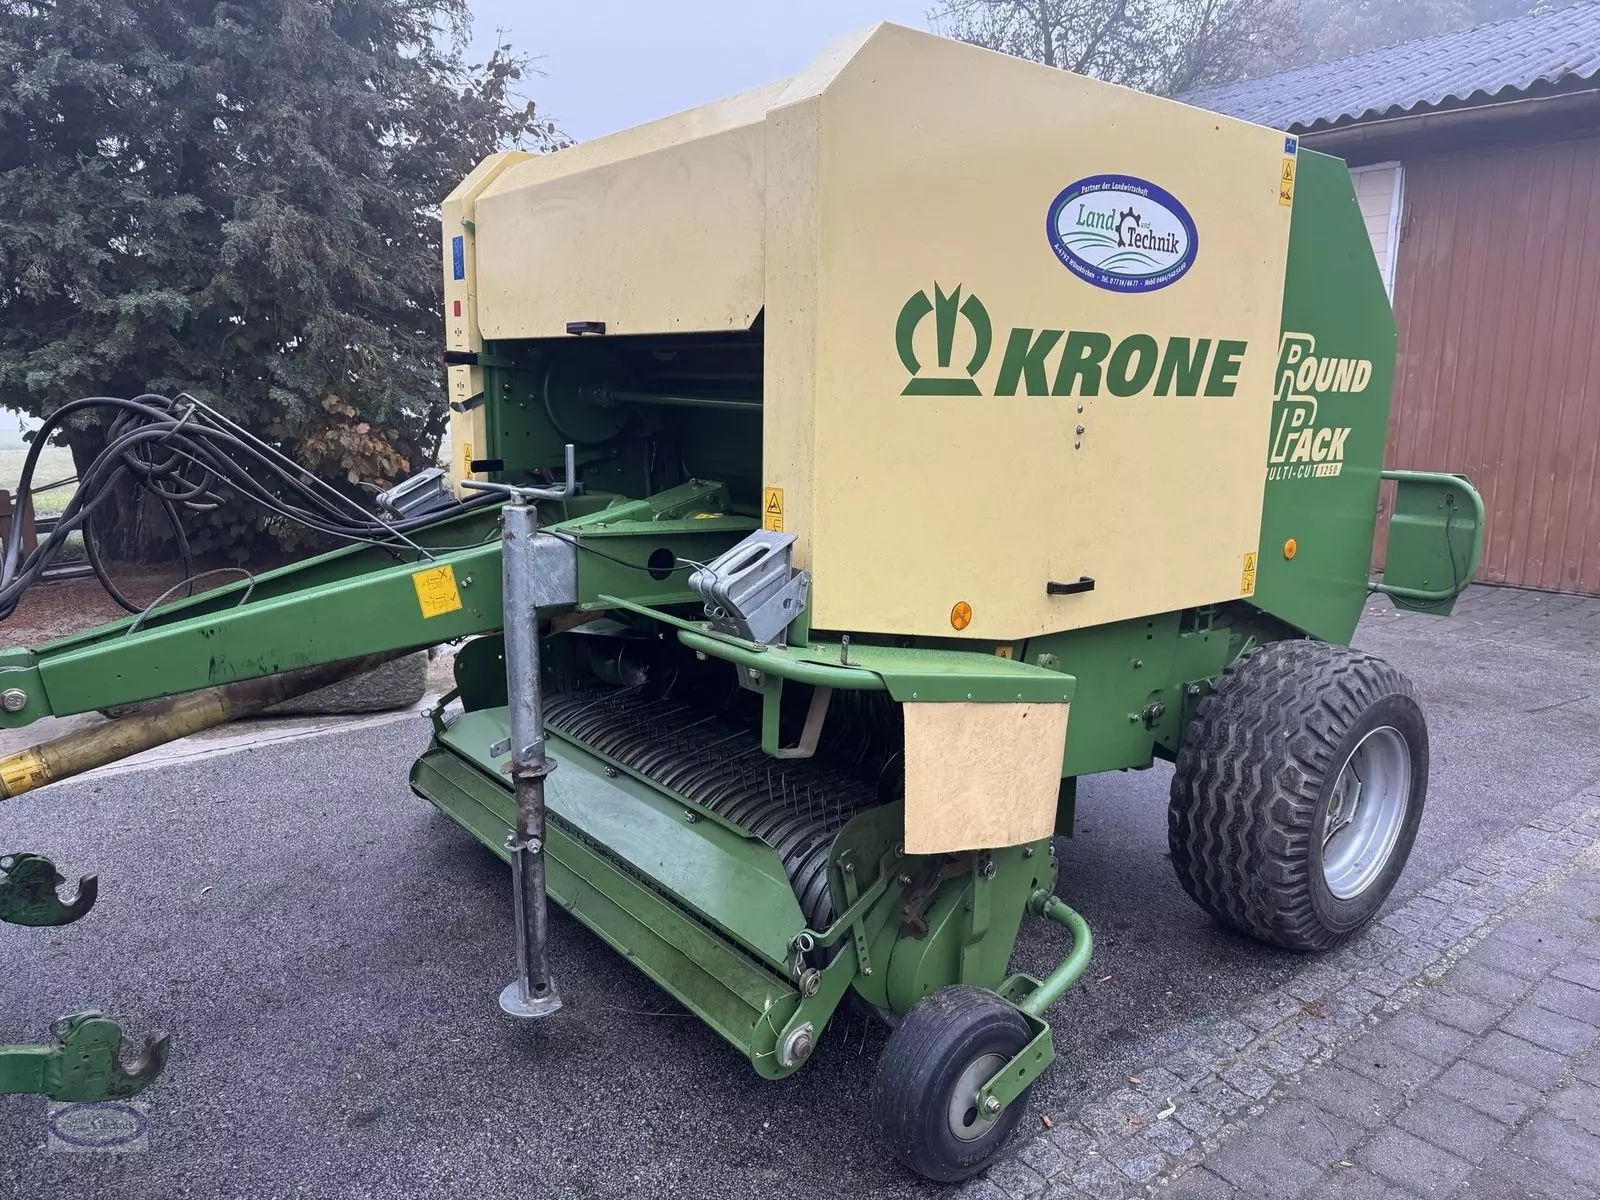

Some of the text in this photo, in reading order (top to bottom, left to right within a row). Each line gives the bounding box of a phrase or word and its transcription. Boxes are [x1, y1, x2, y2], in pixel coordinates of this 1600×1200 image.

[1081, 181, 1149, 197] Partner der Landwirtschaft
[1076, 204, 1116, 231] Land
[1127, 226, 1180, 254] Technik
[994, 327, 1248, 398] KRONE
[1273, 331, 1373, 401] ROUND
[1270, 394, 1351, 464] PACK
[1266, 464, 1339, 481] ULTI-CUT 1250
